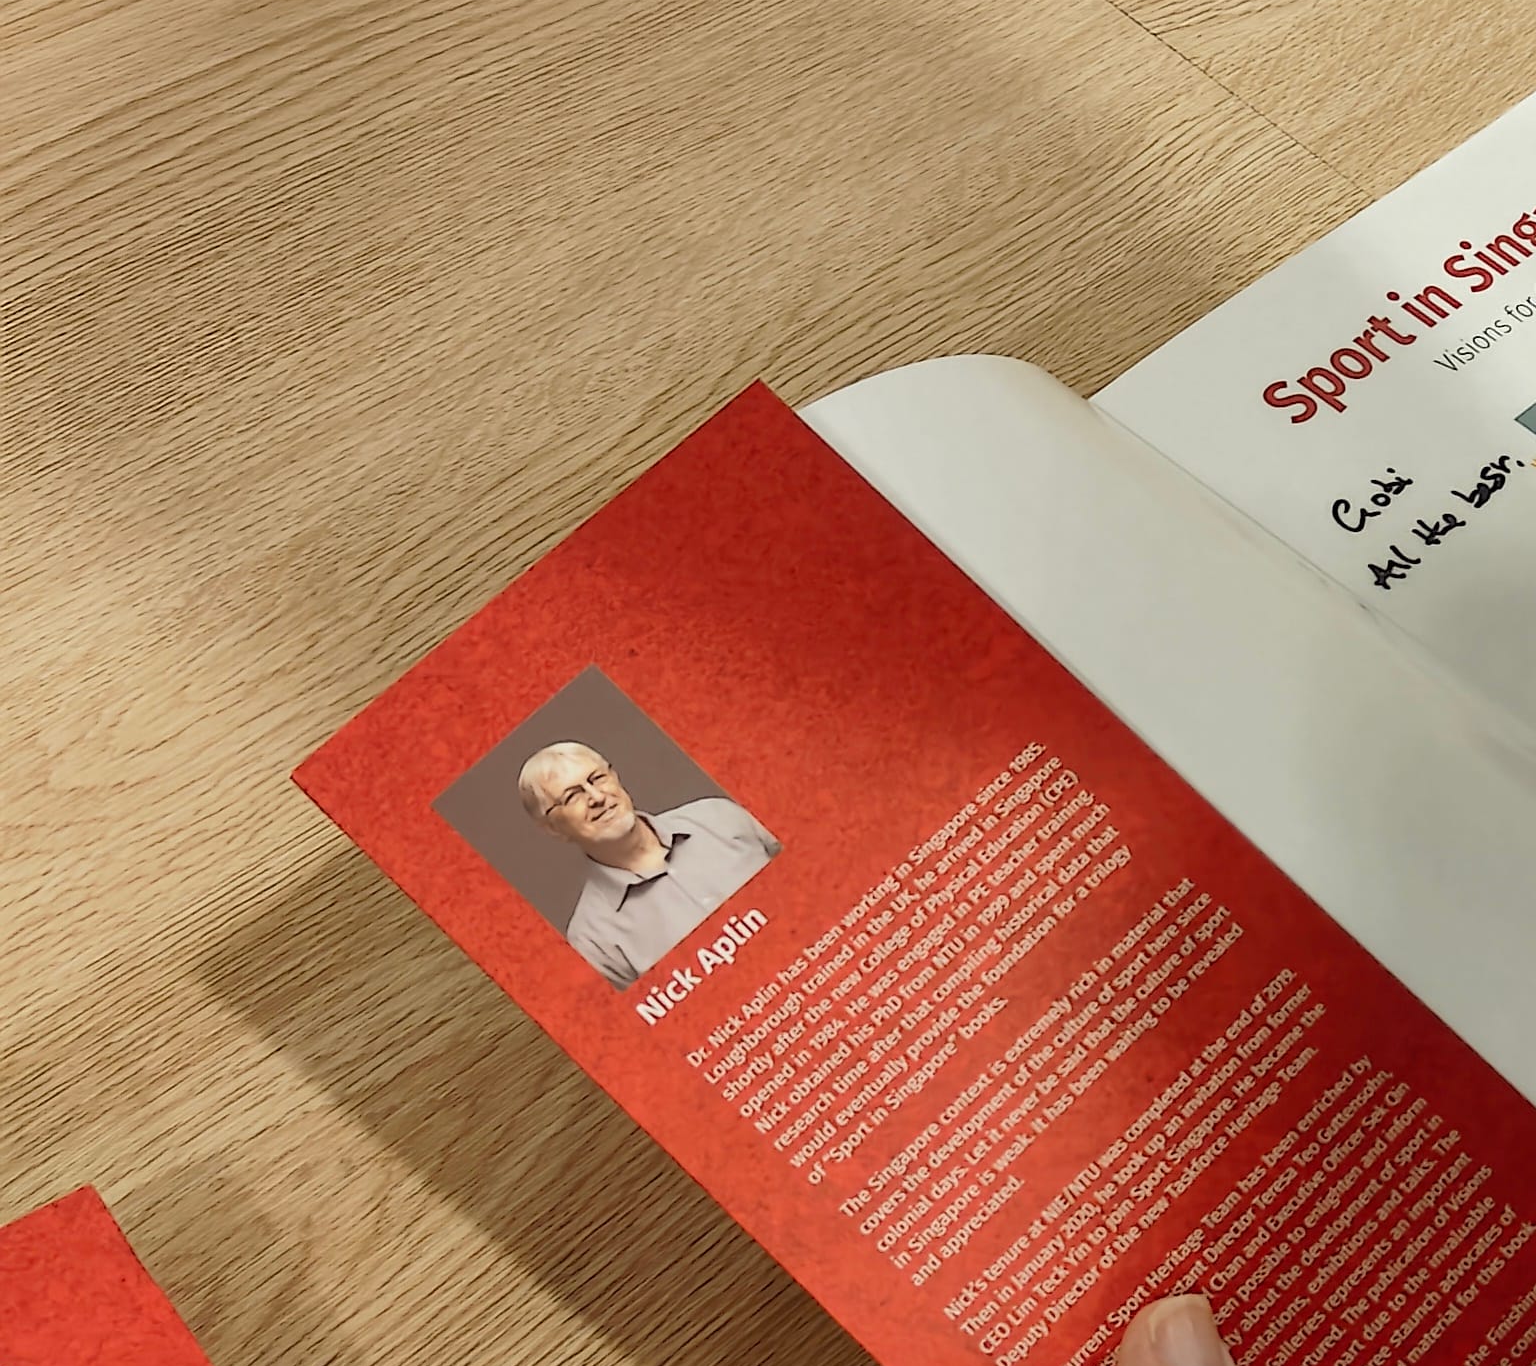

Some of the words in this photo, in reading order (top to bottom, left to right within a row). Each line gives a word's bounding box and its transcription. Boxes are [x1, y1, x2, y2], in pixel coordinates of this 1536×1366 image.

[1262, 313, 1417, 424] Sport
[1386, 291, 1463, 328] in
[1433, 320, 1512, 372] Visions
[702, 991, 807, 1086] Loughborough
[800, 942, 856, 996] trained
[847, 931, 873, 951] in
[864, 909, 896, 936] the
[911, 869, 939, 893] he
[933, 823, 986, 876] arrived
[976, 813, 1001, 833] in
[992, 755, 1064, 820] Singapore
[706, 1014, 747, 1050] Nick
[740, 981, 783, 1022] Aplin
[774, 956, 810, 987] has
[801, 924, 845, 963] been
[839, 872, 902, 929] working
[889, 861, 914, 881] in
[906, 801, 980, 868] Singapore
[974, 770, 1015, 808] since
[1050, 893, 1078, 920] for
[1074, 884, 1091, 901] a
[1082, 843, 1133, 890] trilogy
[634, 966, 704, 1027] Nick
[695, 907, 770, 976] Aplin
[720, 1050, 775, 1103] shortly
[770, 1018, 808, 1057] after
[802, 997, 834, 1025] the
[829, 968, 864, 1002] new
[857, 924, 914, 975] College
[908, 904, 930, 929] of
[922, 857, 984, 915] Physical
[974, 802, 1046, 867] Education
[738, 1060, 797, 1119] opened
[788, 1048, 814, 1069] in
[843, 994, 871, 1019] He
[866, 967, 901, 999] was
[895, 911, 958, 973] engaged
[949, 900, 974, 920] in
[965, 879, 993, 906] PE
[985, 835, 1041, 888] teacher
[772, 1090, 838, 1153] research
[830, 1059, 871, 1095] time
[866, 1025, 904, 1065] after
[898, 998, 937, 1032] that
[930, 935, 1004, 1004] compiling
[992, 877, 1063, 944] historical
[1056, 851, 1093, 886] data
[1085, 824, 1121, 857] that
[955, 982, 987, 1011] the
[979, 914, 1059, 988] foundation
[833, 1054, 910, 1127] eventually
[836, 1188, 874, 1219] The
[866, 1121, 942, 1194] Singapore
[937, 1071, 995, 1127] context
[985, 1058, 1008, 1078] is
[1003, 994, 1073, 1064] extremely
[1067, 970, 1100, 1001] rich
[1091, 955, 1115, 976] in
[1109, 901, 1169, 961] material
[1161, 876, 1196, 908] that
[904, 1005, 962, 1063] provide
[788, 1119, 838, 1169] would
[958, 1299, 1002, 1337] Then
[992, 1284, 1017, 1305] in
[1008, 1233, 1066, 1292] January
[1091, 1181, 1119, 1206] he
[1110, 1149, 1150, 1187] took
[1142, 1132, 1167, 1157] up
[1161, 1114, 1186, 1138] an
[1176, 1055, 1243, 1119] invitation
[1235, 1025, 1273, 1060] from
[1265, 982, 1313, 1030] former
[1041, 1263, 1103, 1325] Director
[1097, 1243, 1119, 1271] of
[1111, 1225, 1143, 1254] the
[1136, 1195, 1171, 1230] new
[1162, 1135, 1231, 1200] Taskforce
[1223, 1080, 1284, 1140] Heritage
[1105, 1284, 1151, 1329] Sport
[1143, 1227, 1207, 1290] Heritage
[1198, 1190, 1243, 1230] Team
[1235, 1164, 1268, 1194] has
[1259, 1129, 1300, 1169] been
[1296, 1069, 1355, 1133] enriched
[1348, 1053, 1373, 1076] by
[1361, 1309, 1392, 1342] due
[1386, 1292, 1407, 1313] to
[1402, 1266, 1431, 1295] the
[1427, 1195, 1497, 1269] invaluable
[1405, 1301, 1464, 1365] material
[1455, 1282, 1481, 1308] for
[1475, 1255, 1507, 1286] this
